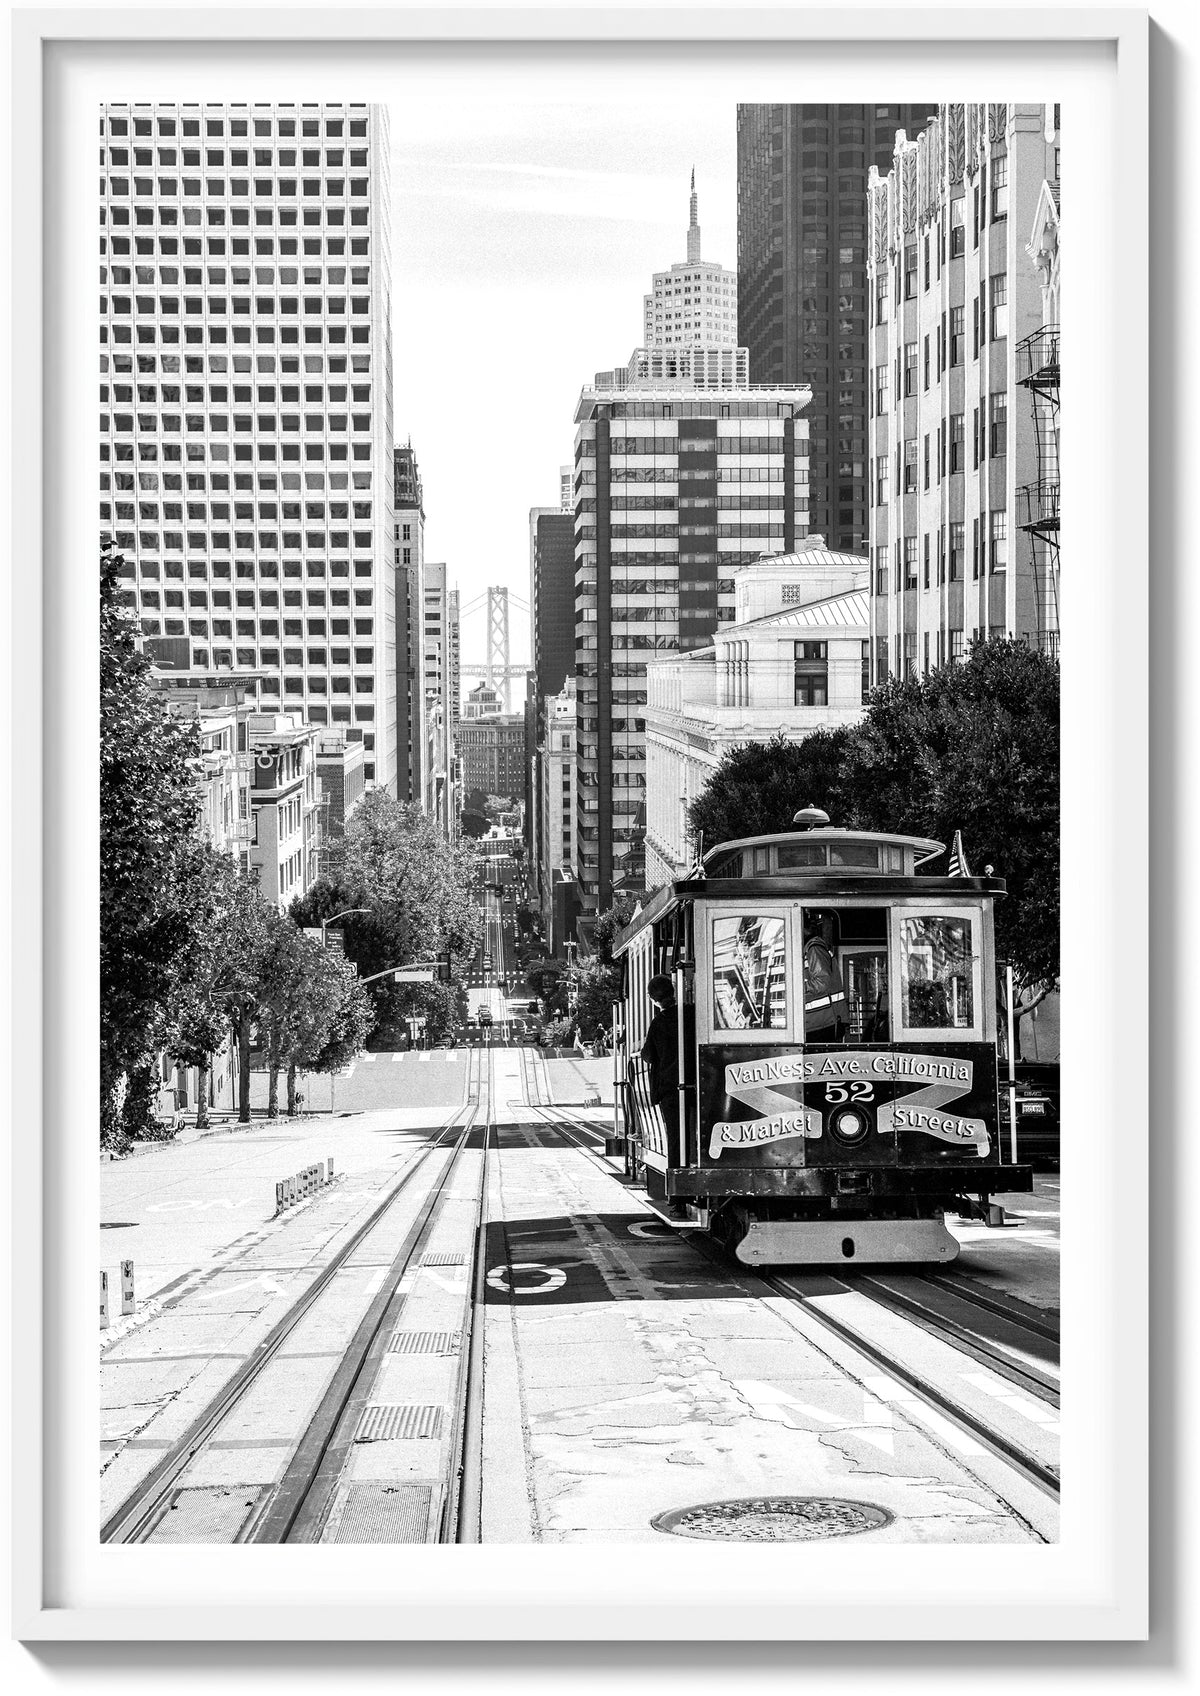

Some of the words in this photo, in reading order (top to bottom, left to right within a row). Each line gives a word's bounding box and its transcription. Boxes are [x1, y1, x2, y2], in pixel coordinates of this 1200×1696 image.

[872, 1056, 969, 1081] California
[824, 1080, 875, 1103] 52
[721, 1124, 736, 1142] &
[738, 1114, 812, 1142] Market
[893, 1108, 976, 1138] Streets
